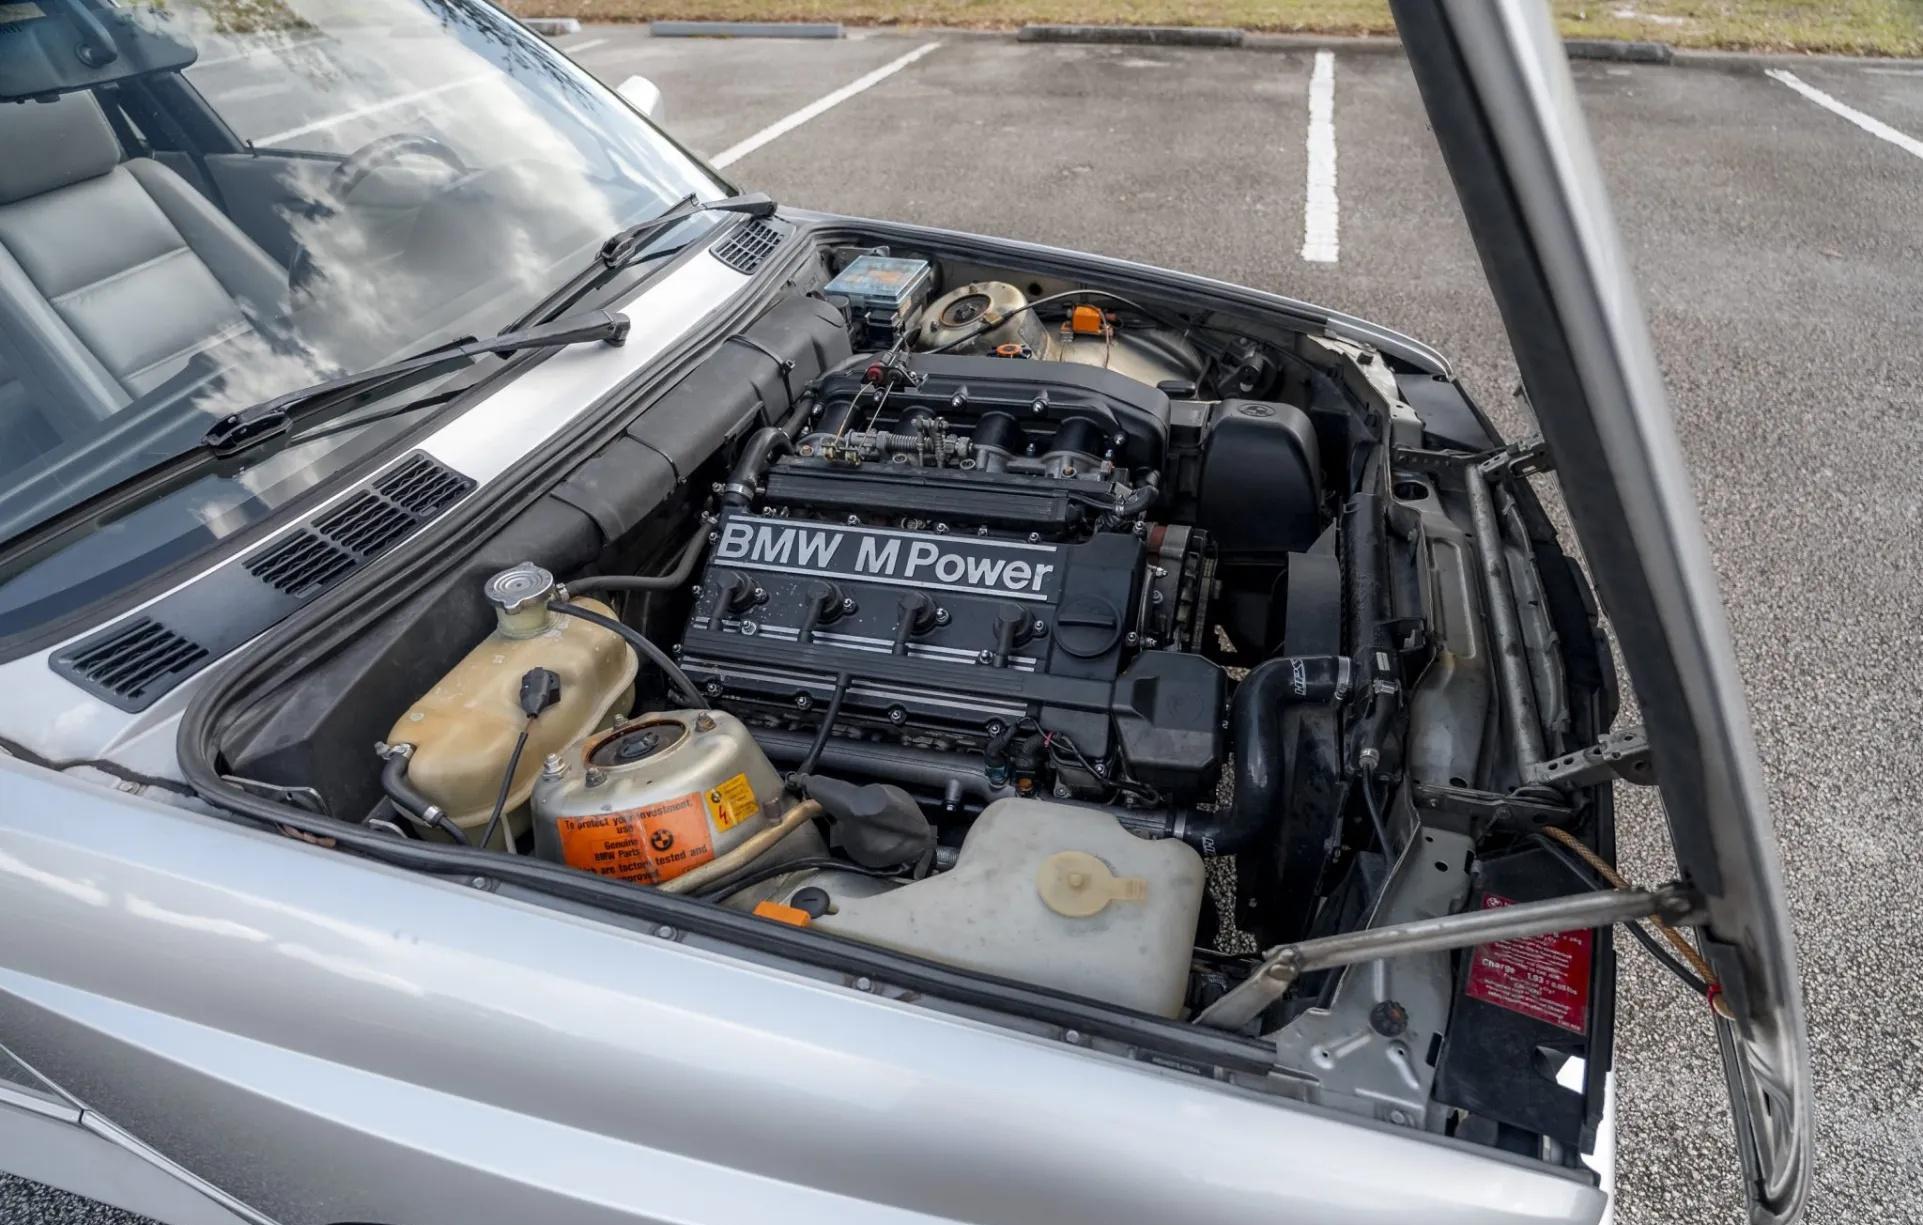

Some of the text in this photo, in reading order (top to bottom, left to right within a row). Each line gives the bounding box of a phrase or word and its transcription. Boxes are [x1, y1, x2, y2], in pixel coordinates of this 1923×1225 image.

[717, 523, 843, 568] BMW
[563, 819, 575, 831] To
[577, 817, 609, 831] protect
[618, 848, 640, 858] Parts
[655, 850, 687, 866] tested
[1481, 958, 1516, 975] Charge
